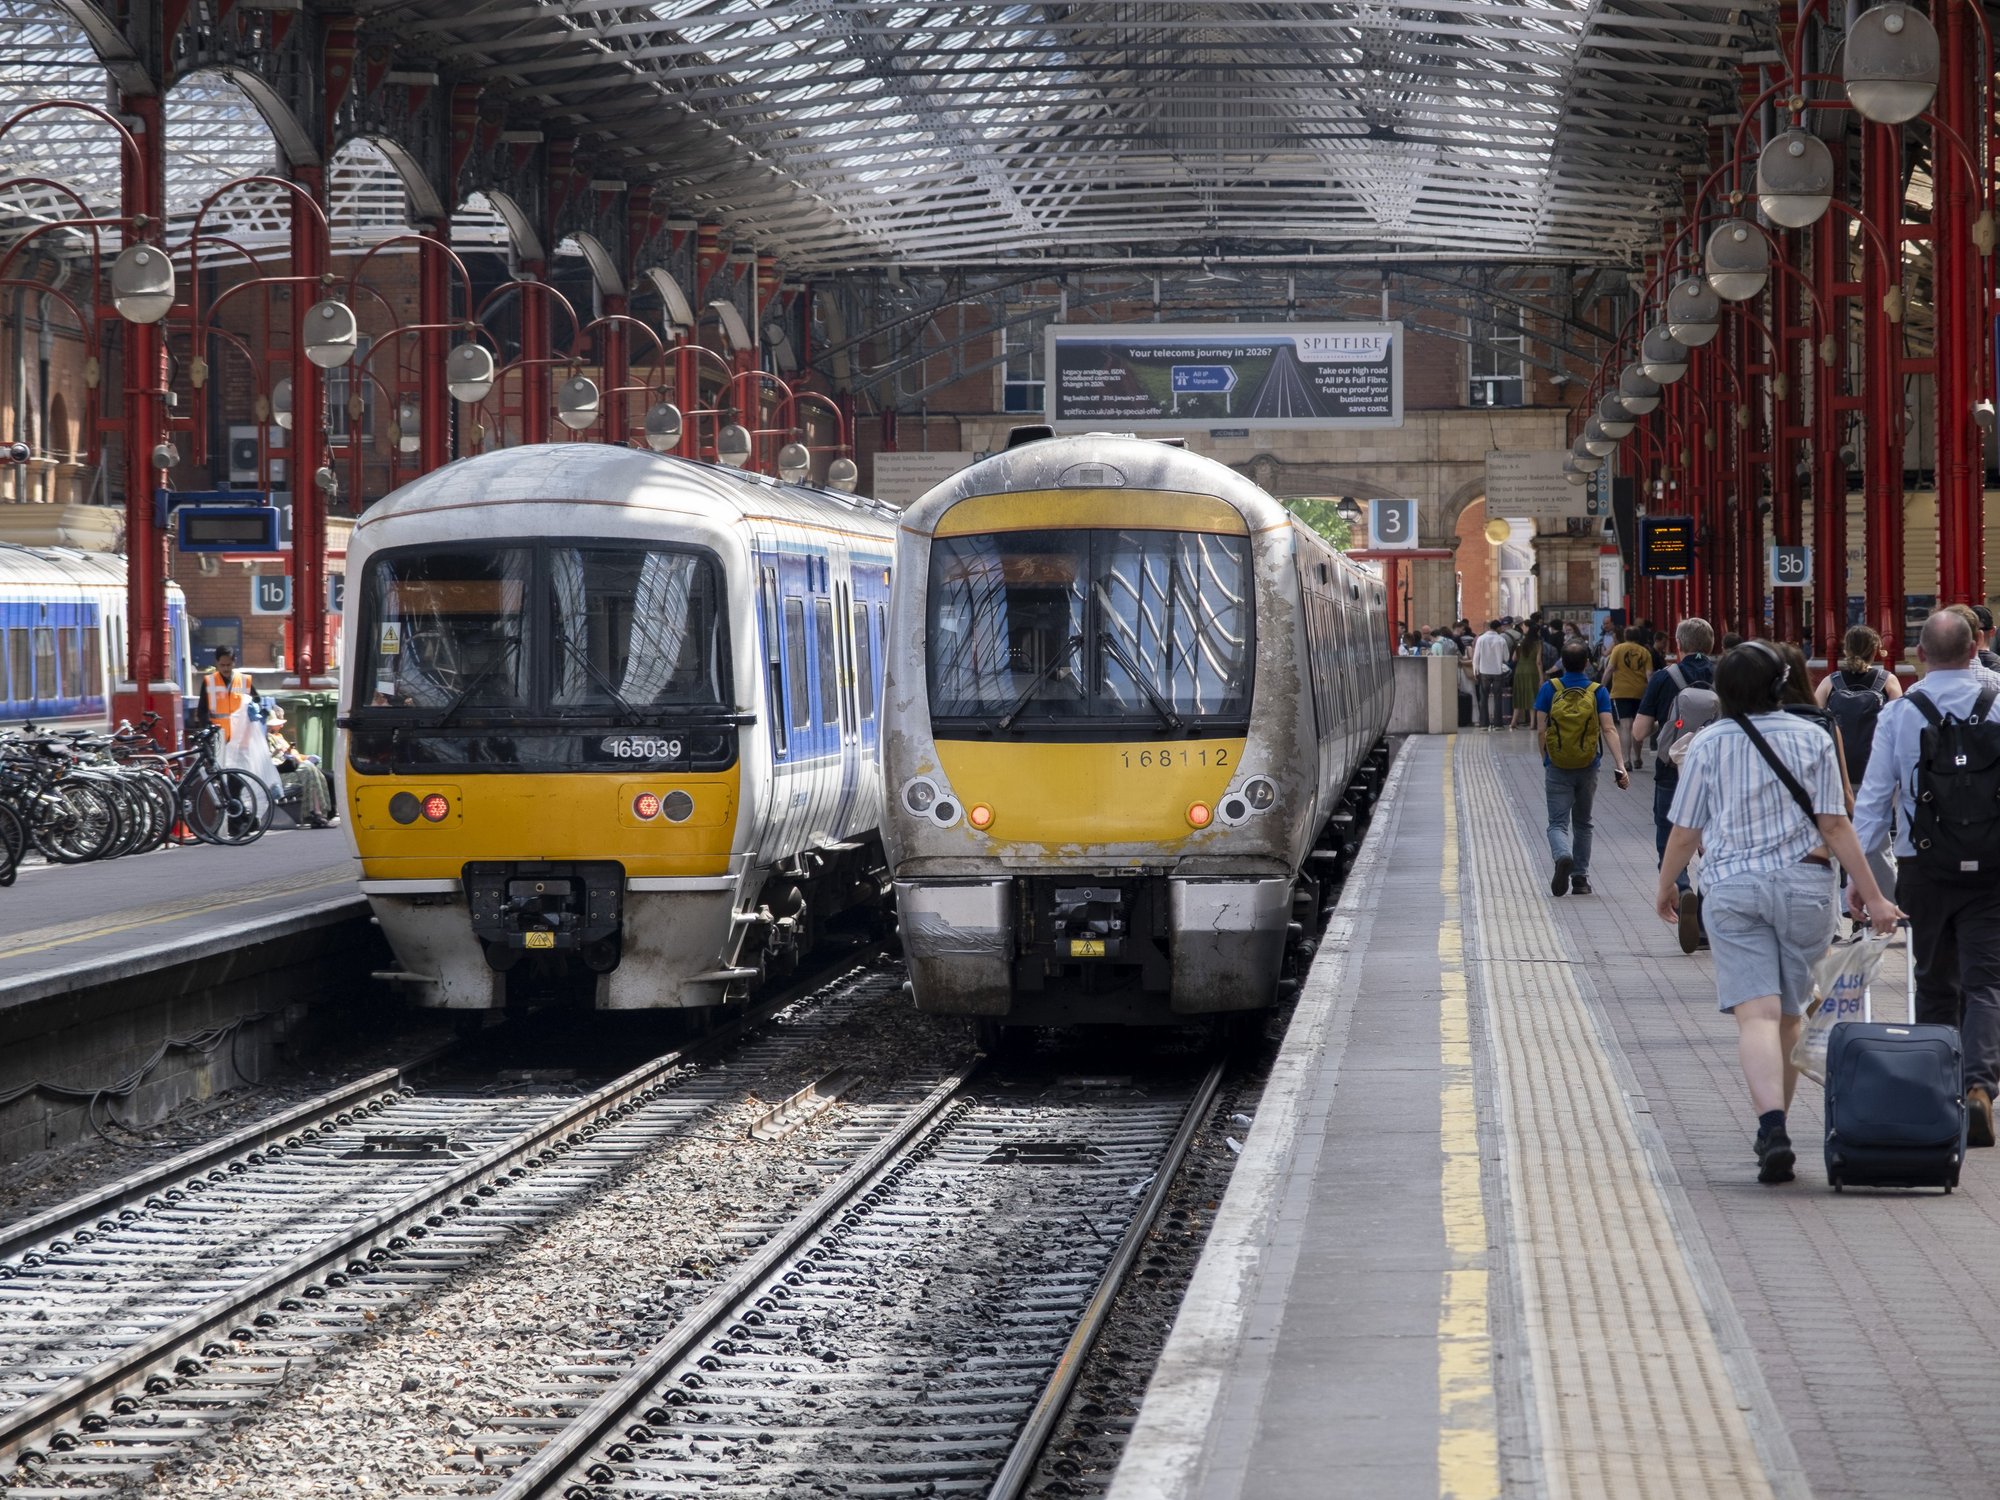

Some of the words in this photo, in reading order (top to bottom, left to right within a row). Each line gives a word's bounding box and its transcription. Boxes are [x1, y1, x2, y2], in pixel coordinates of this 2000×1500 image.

[1303, 337, 1382, 349] SPITFIRE
[1129, 349, 1151, 358] Your
[1153, 348, 1195, 358] telecoms
[1196, 348, 1232, 359] journey
[1234, 347, 1244, 357] in
[1246, 347, 1272, 357] 2026?
[1318, 366, 1337, 375] Take
[1353, 366, 1369, 376] high
[1370, 366, 1388, 375] road
[1324, 376, 1335, 384] All
[1336, 376, 1344, 384] IP
[1344, 376, 1351, 384] &
[1352, 376, 1366, 384] Full
[1367, 376, 1389, 384] Fibre.
[1322, 386, 1348, 394] Future
[1348, 385, 1370, 395] proof
[1370, 387, 1388, 395] your
[1339, 395, 1373, 403] business
[1373, 395, 1389, 403] and
[1386, 509, 1401, 533] 3
[1778, 553, 1804, 574] 3b
[261, 582, 284, 602] 1b
[610, 740, 682, 758] 165039
[1121, 748, 1228, 768] 168112
